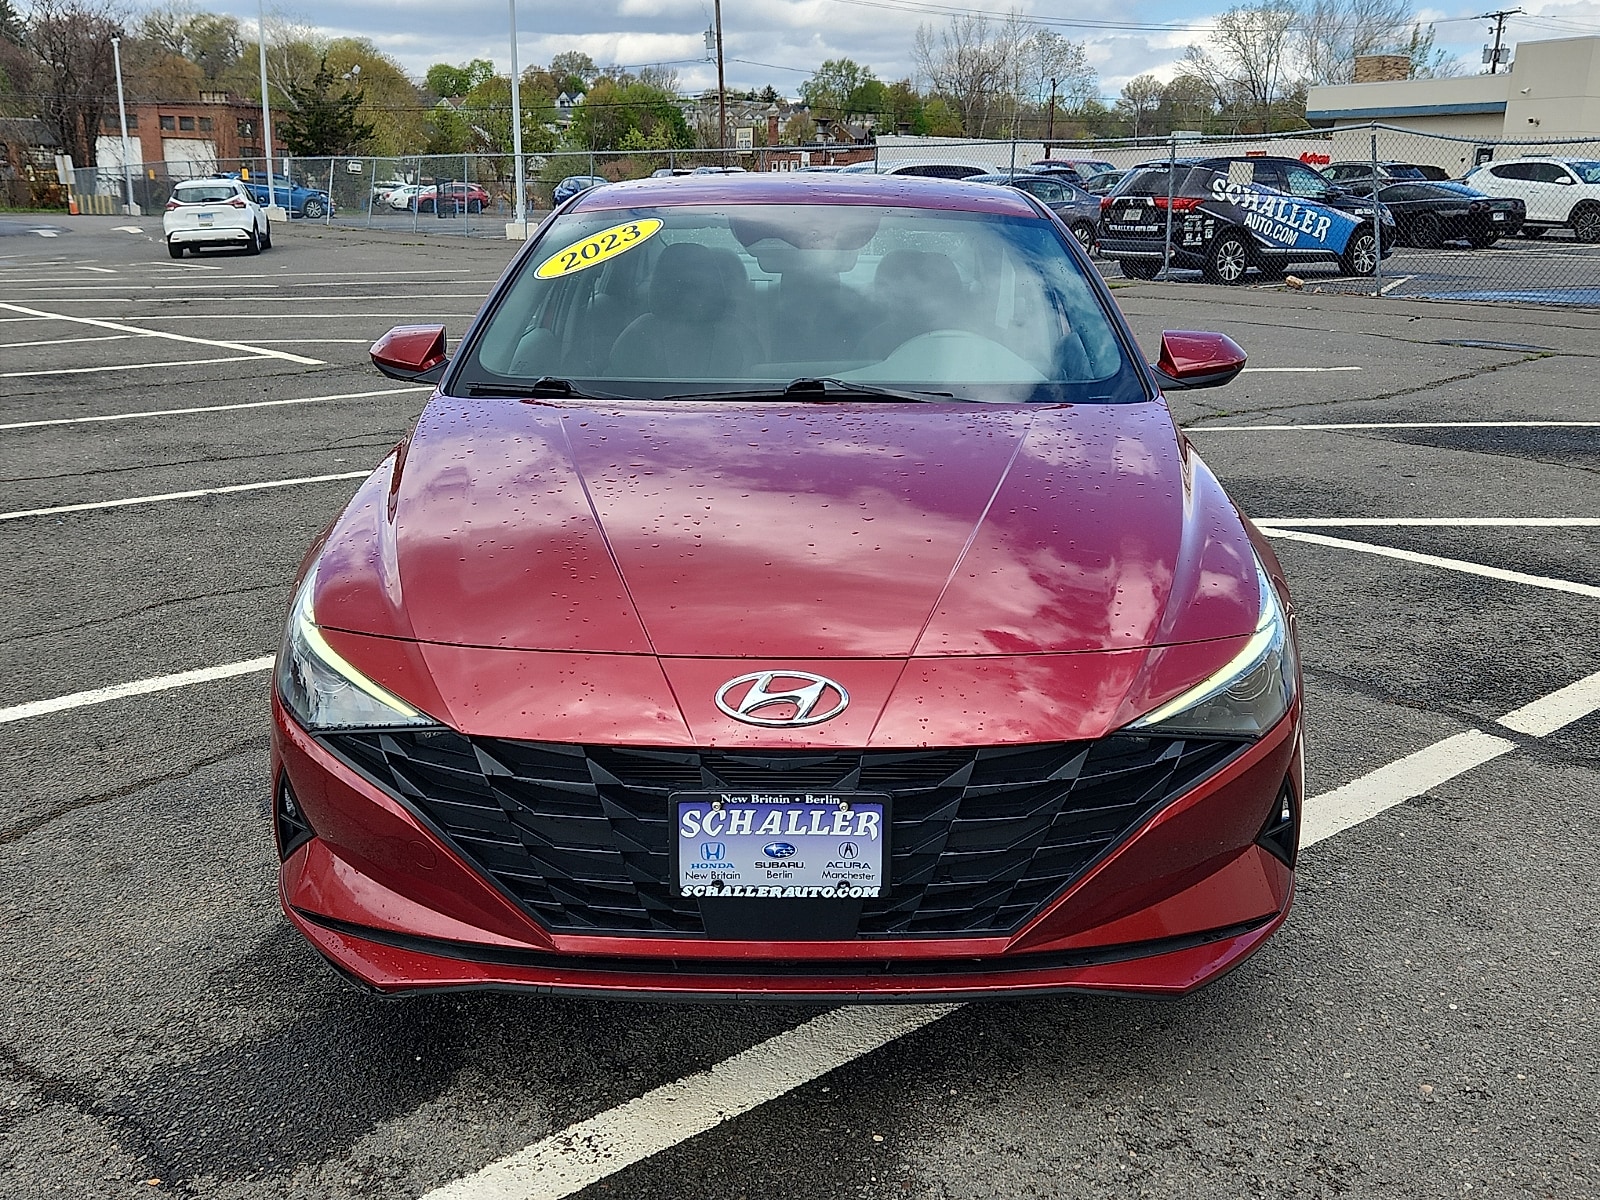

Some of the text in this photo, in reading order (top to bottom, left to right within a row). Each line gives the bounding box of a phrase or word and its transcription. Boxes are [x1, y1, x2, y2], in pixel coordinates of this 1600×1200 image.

[1211, 179, 1331, 243] SCHALLER
[1243, 212, 1299, 247] AUTO.COM
[560, 225, 641, 271] 2023
[720, 794, 841, 805] New Britain Berlin
[680, 809, 880, 841] SCHALLER
[825, 862, 872, 870] ACURA
[685, 871, 741, 880] New Britain
[766, 870, 793, 879] Berlin
[821, 871, 875, 880] Manchester
[680, 885, 881, 899] SCHALLERAUTO.COM
